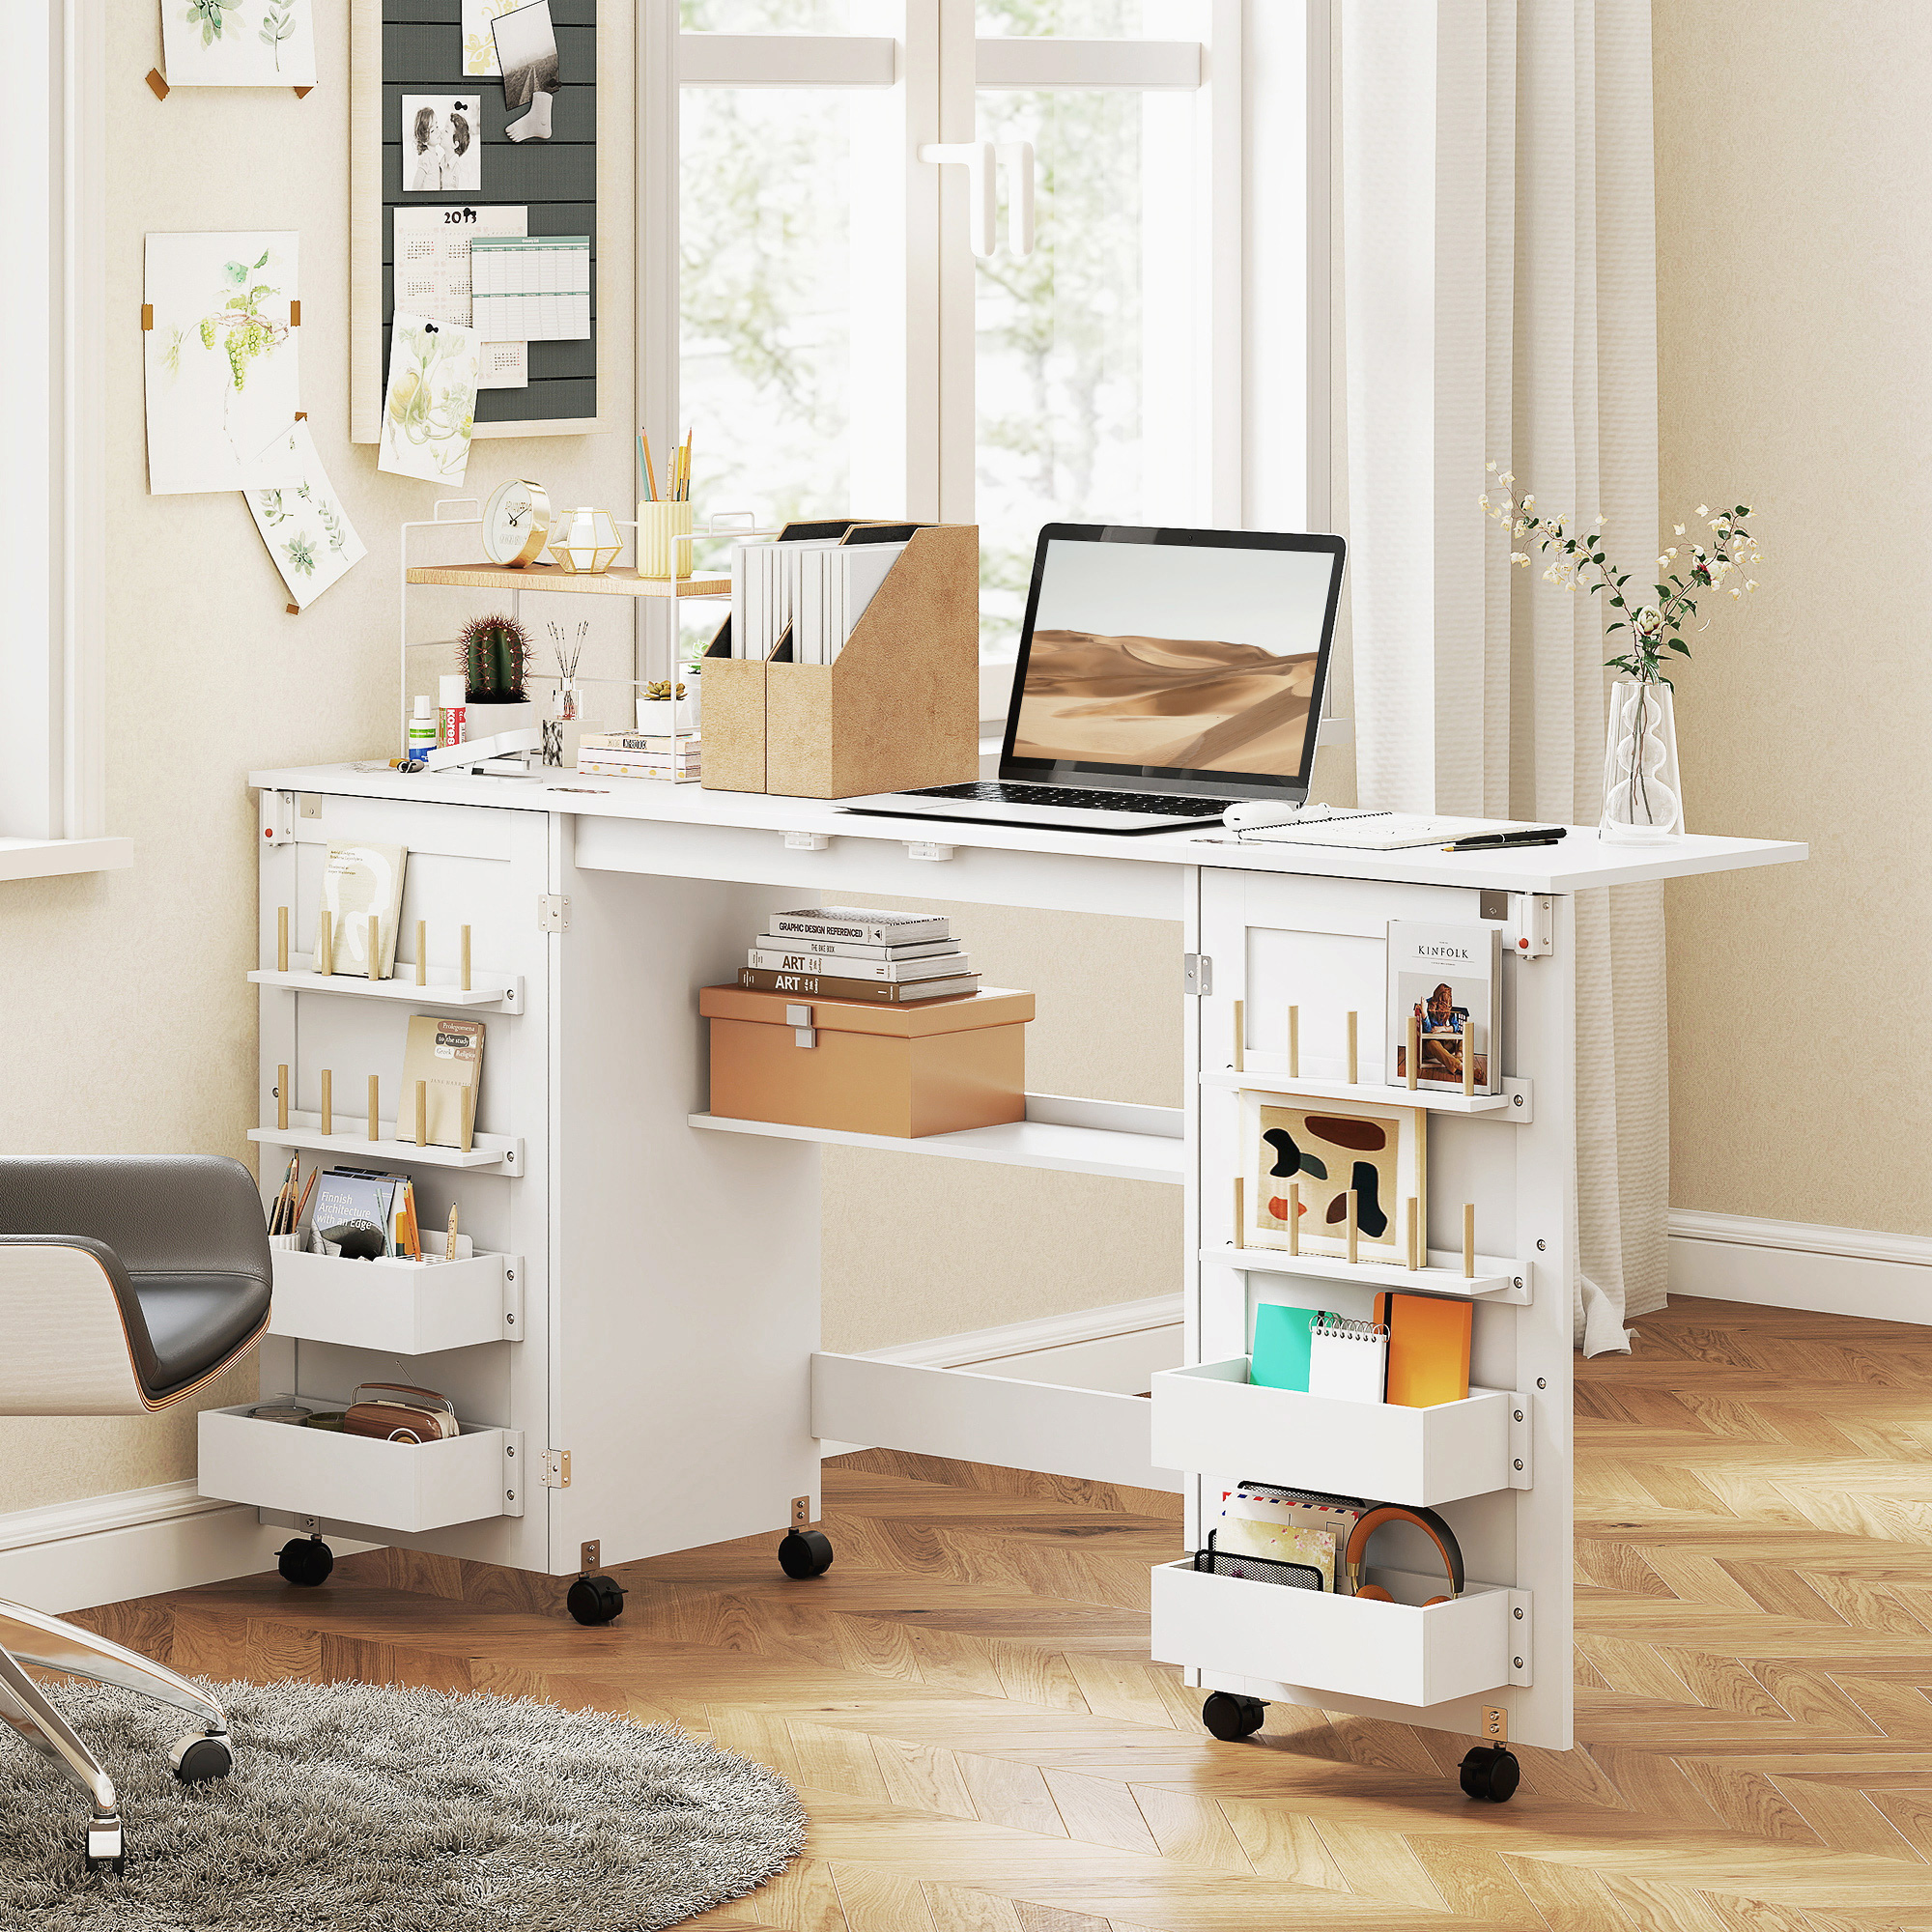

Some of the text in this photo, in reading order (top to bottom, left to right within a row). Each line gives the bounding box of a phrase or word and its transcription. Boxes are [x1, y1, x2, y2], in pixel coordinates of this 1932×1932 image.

[779, 922, 804, 932] GRAPHIC
[805, 924, 825, 935] DESIGN
[826, 927, 863, 938] REFERENCED
[1418, 945, 1469, 959] KINFOLK
[782, 955, 805, 970] ART
[775, 975, 801, 991] ART
[443, 1023, 475, 1032] Prolegomena
[455, 1037, 468, 1046] study
[321, 1192, 353, 1204] Finnish
[319, 1202, 371, 1218] Architecture
[317, 1214, 335, 1224] with
[350, 1218, 372, 1231] Edge
